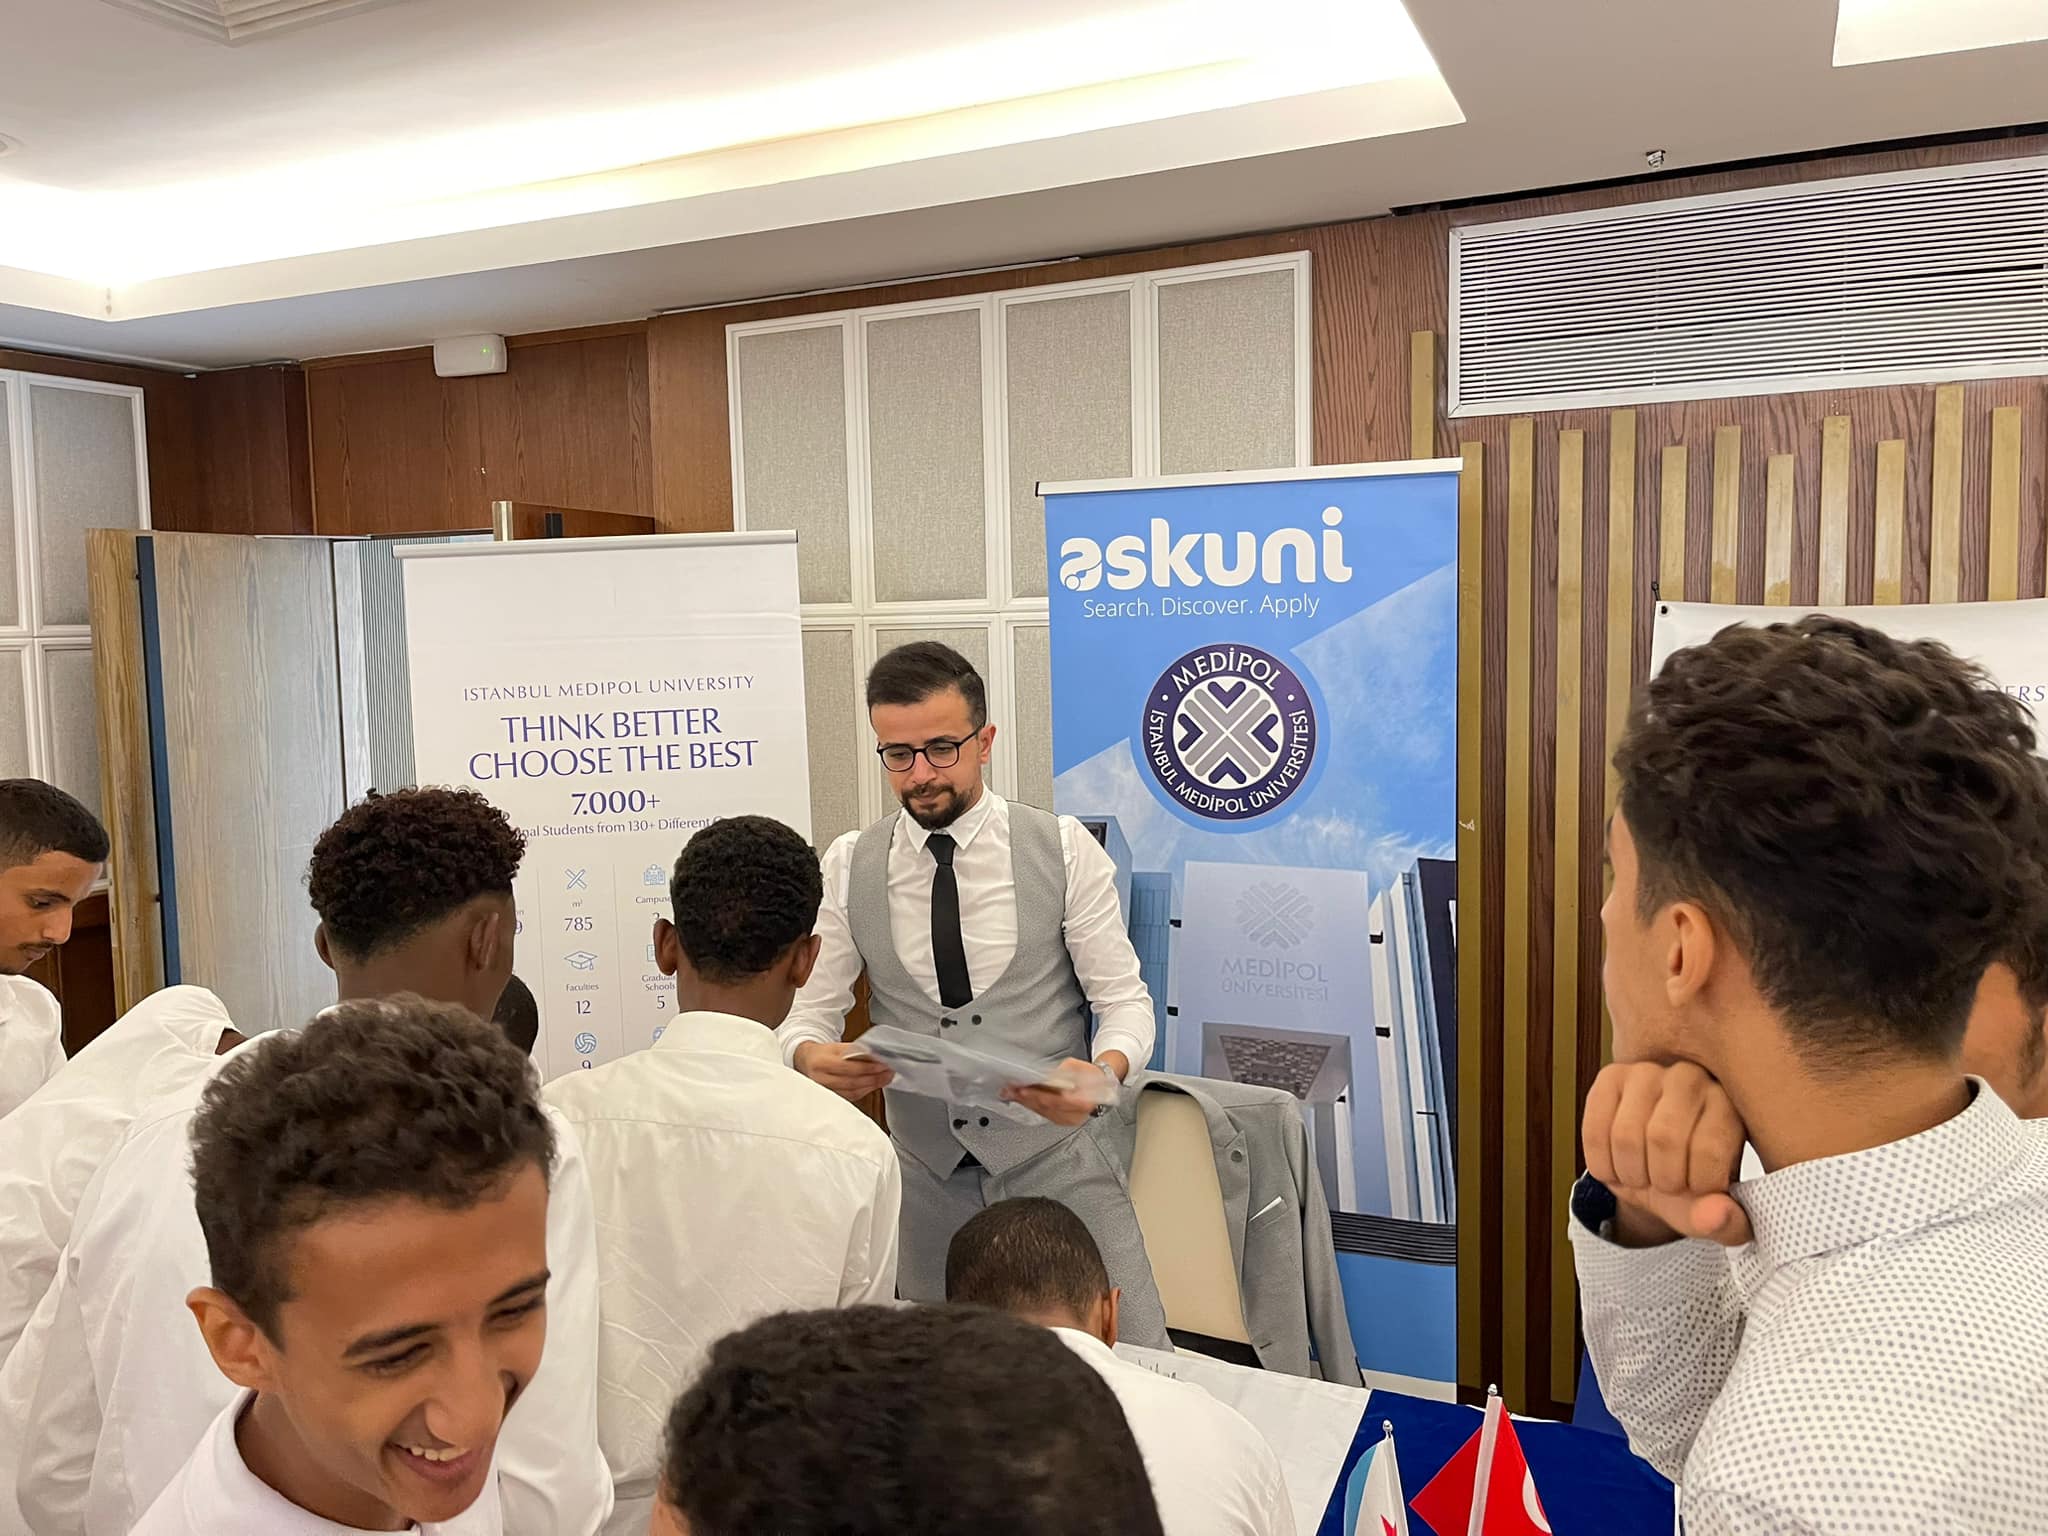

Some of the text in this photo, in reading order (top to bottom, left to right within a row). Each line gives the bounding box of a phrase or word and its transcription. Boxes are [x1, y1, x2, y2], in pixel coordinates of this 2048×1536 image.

[1059, 505, 1353, 592] askuni
[1083, 593, 1320, 618] Search. Discover. Apply
[1171, 647, 1281, 693] MEDİPOL
[463, 675, 755, 701] ISTANBUL MEDIPOL UNIVERSITY
[500, 707, 722, 743] THINK BETTER
[469, 740, 758, 780] CHOOSE THE BEST
[1149, 709, 1308, 814] İSTANBUL MEDİPOL ÜNİVERSİTESİ
[571, 789, 661, 815] 7.000+
[543, 824, 594, 836] Students
[597, 822, 625, 833] from
[628, 820, 656, 832] 130+
[659, 817, 710, 830] Different
[564, 917, 593, 931] 785
[566, 983, 599, 991] Faculties
[645, 982, 676, 991] Schools
[576, 1000, 591, 1014] 12
[657, 995, 665, 1009] 5
